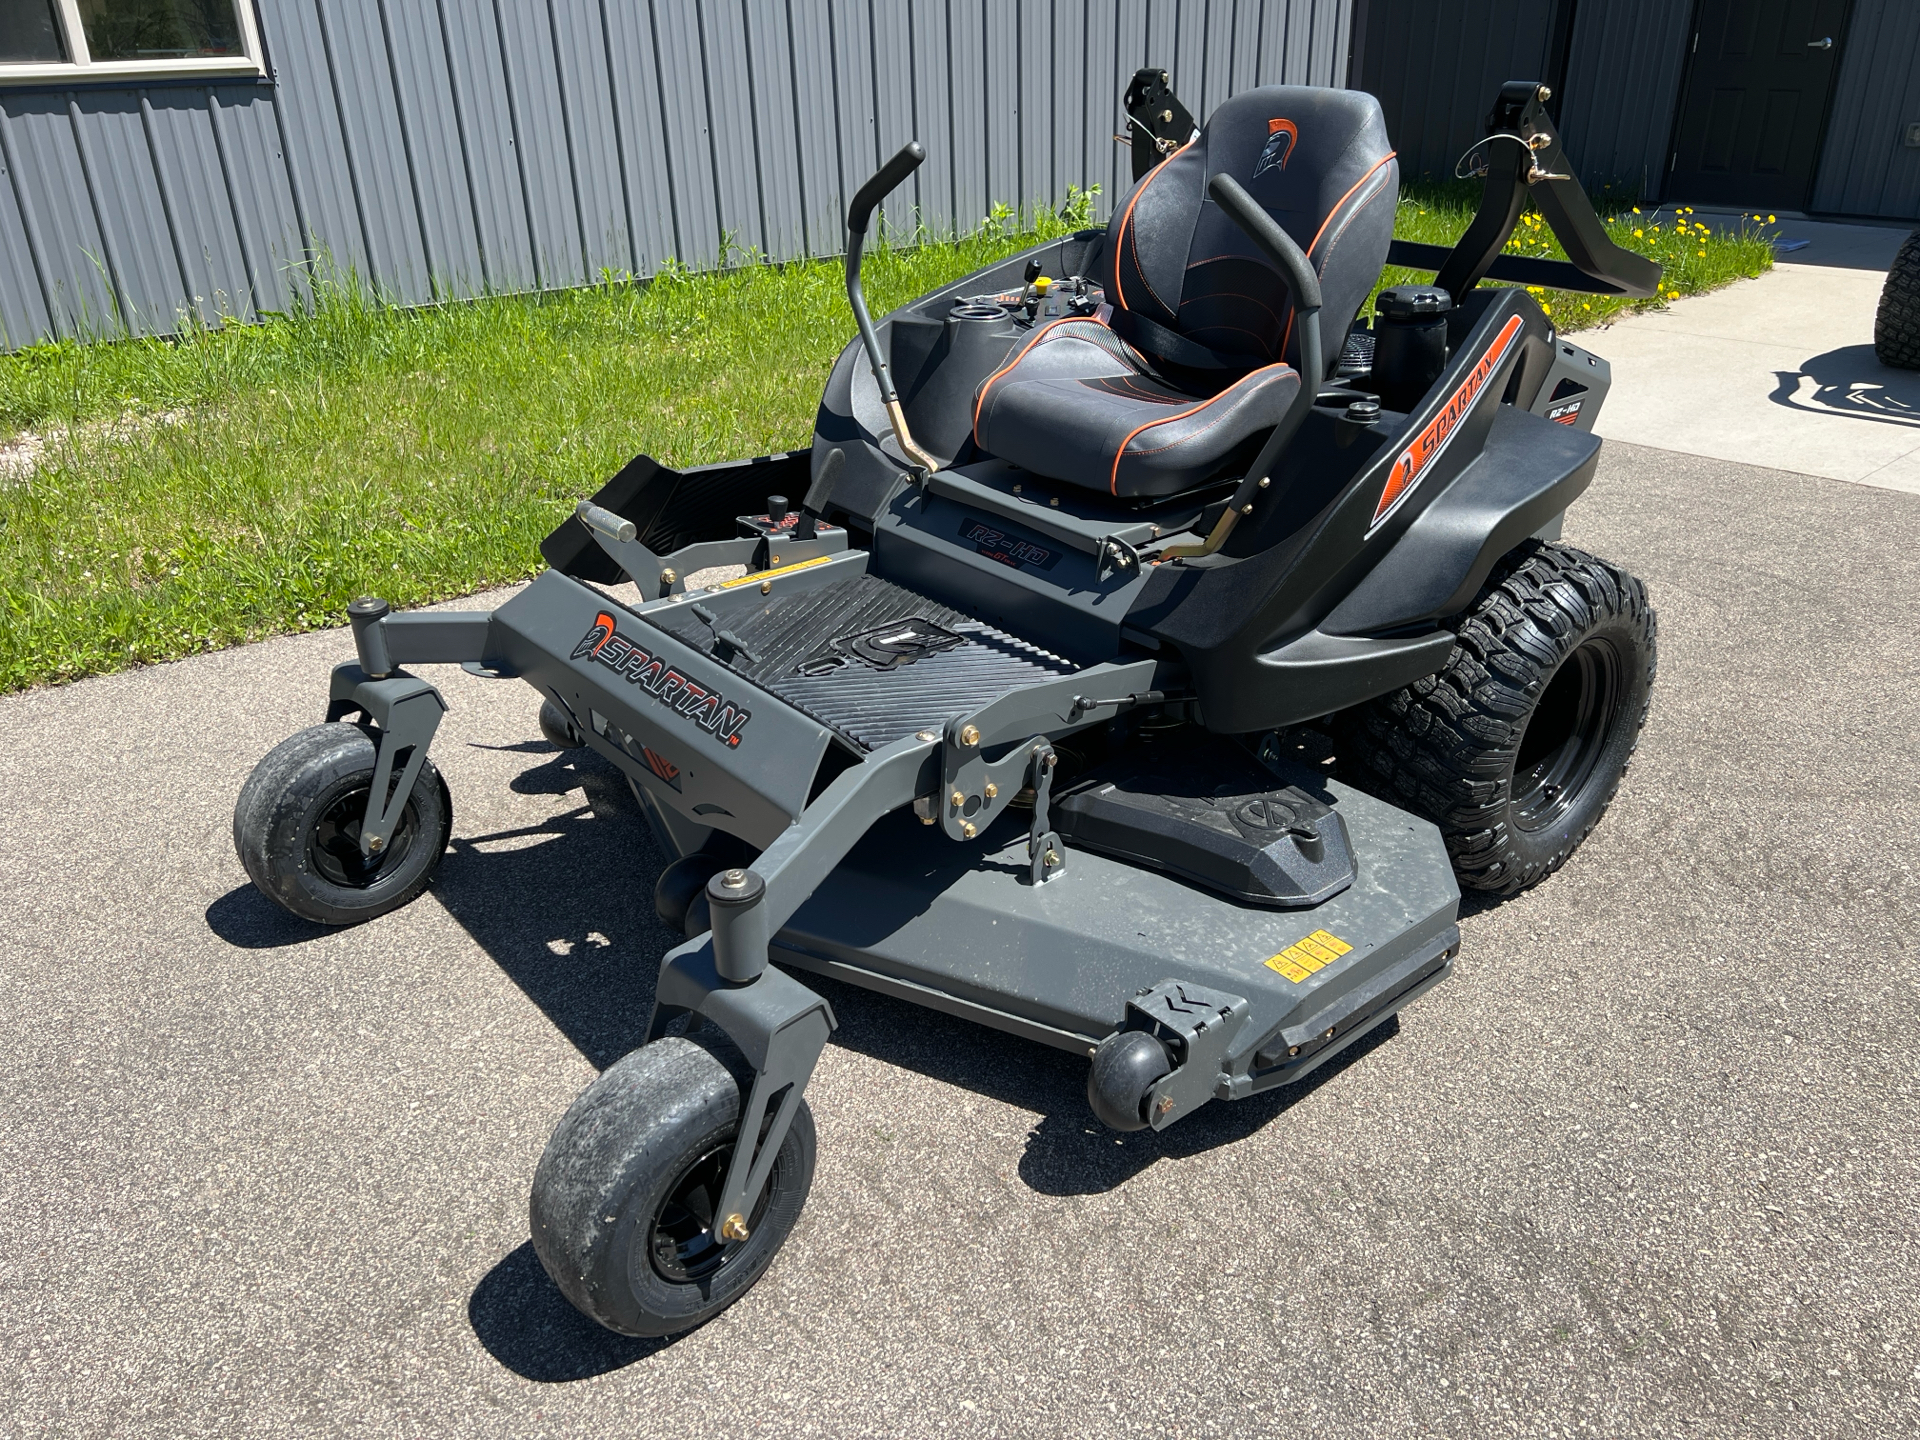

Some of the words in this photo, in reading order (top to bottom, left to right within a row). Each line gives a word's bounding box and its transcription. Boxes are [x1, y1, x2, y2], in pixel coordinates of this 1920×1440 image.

[1422, 352, 1492, 462] SPARTAN
[1549, 402, 1581, 419] RZ-HD
[967, 524, 1050, 566] RZ-HD
[597, 635, 748, 739] SPARTAN
